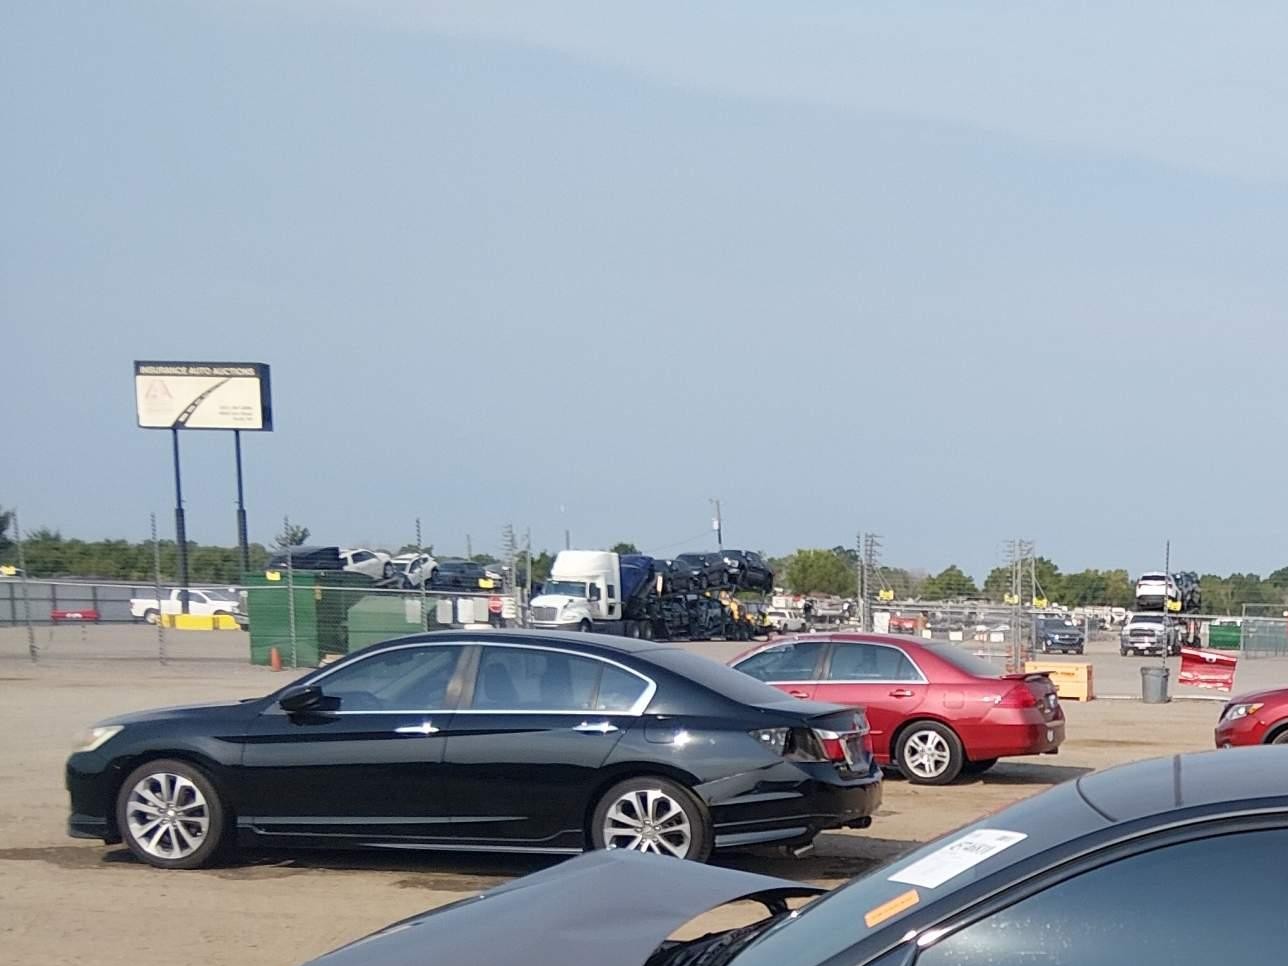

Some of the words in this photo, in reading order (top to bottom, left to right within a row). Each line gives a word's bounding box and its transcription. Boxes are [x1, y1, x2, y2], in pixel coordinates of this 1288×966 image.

[140, 366, 188, 375] INSURANCE
[188, 366, 213, 376] AUTO
[213, 367, 256, 376] AUCTIONS
